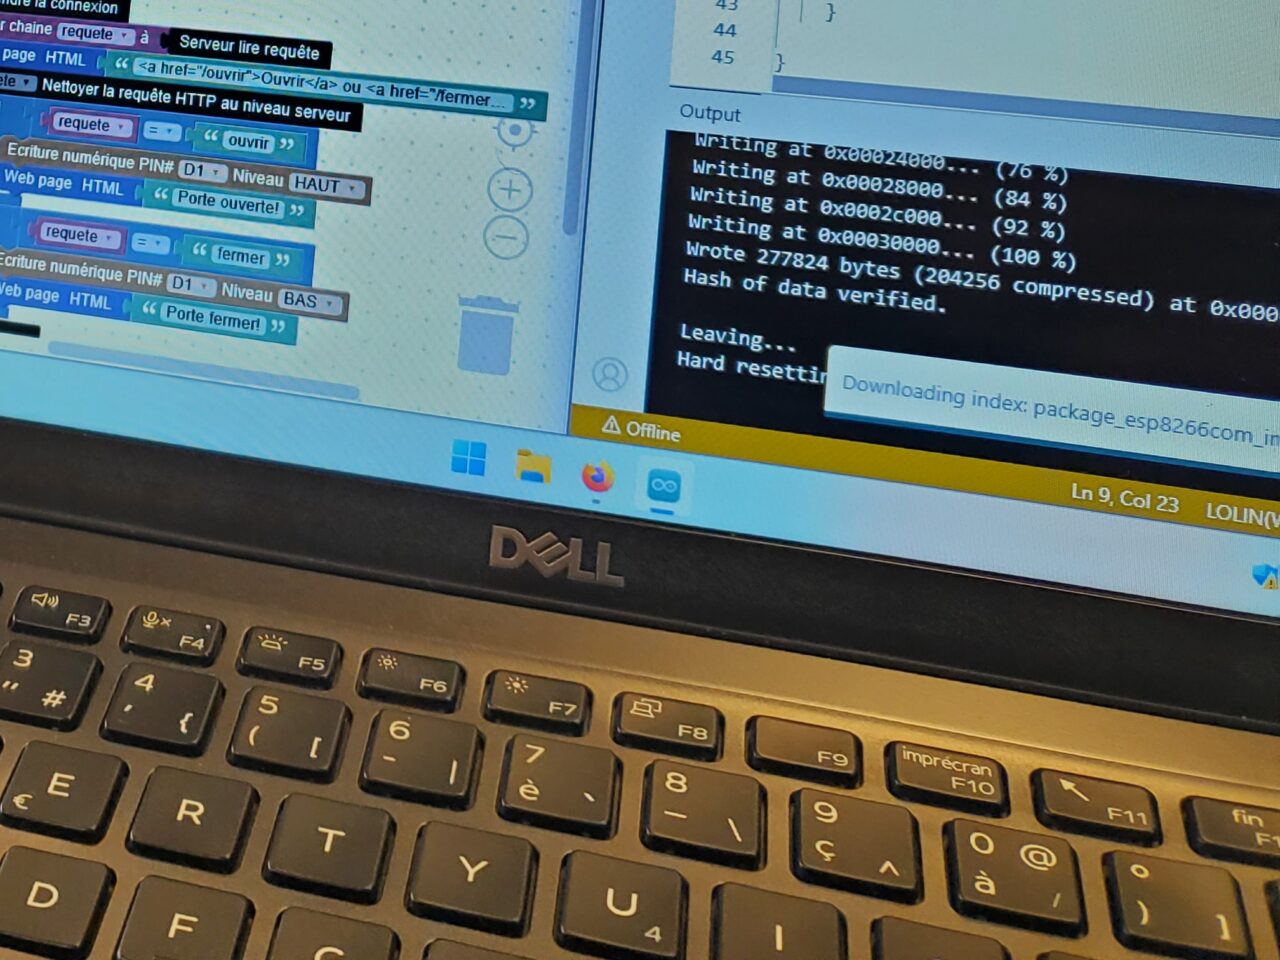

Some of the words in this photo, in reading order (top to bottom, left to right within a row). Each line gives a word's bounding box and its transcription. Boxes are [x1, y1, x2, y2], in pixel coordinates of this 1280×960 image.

[3, 47, 36, 62] page
[46, 51, 86, 67] HTML
[180, 34, 235, 53] Serveur
[239, 40, 260, 54] lire
[265, 43, 320, 61] requête
[712, 50, 734, 64] 45
[43, 79, 99, 99] Nettoyer
[176, 93, 217, 108] HTTP
[243, 98, 291, 117] niveau
[295, 107, 351, 123] serveur
[680, 103, 741, 124] Output
[229, 134, 269, 150] ouvrir
[695, 133, 777, 158] Writing
[295, 175, 340, 194] HAUT
[178, 191, 217, 208] Porte
[221, 195, 279, 215] ouverte!
[46, 224, 98, 243] requete
[218, 247, 265, 266] fermer
[991, 245, 1040, 266] (100
[687, 241, 746, 262] Wrote
[757, 249, 828, 271] 277824
[840, 257, 901, 279] bytes
[916, 264, 1001, 290] (204256
[1013, 279, 1154, 312] compressed)
[685, 268, 731, 288] Hash
[778, 278, 826, 300] data
[838, 286, 946, 314] verified.
[210, 310, 261, 331] fermer!
[680, 323, 796, 352] Leaving...
[677, 350, 725, 371] Hard
[843, 374, 965, 409] Downloading
[972, 391, 1028, 414] index:
[627, 421, 681, 442] Offline
[1071, 482, 1092, 501] Ln
[1120, 490, 1151, 510] Col
[1155, 495, 1179, 514] 23
[490, 525, 624, 588] DELL
[66, 612, 92, 627] F3
[299, 656, 325, 671] F5
[679, 724, 708, 740] F8
[902, 746, 992, 778] imprécran
[47, 772, 76, 798] E
[951, 777, 995, 797] F10
[176, 799, 205, 826] R
[1108, 807, 1148, 825] F11
[1232, 808, 1264, 827] fin
[318, 826, 346, 853] T
[459, 855, 489, 883] Y
